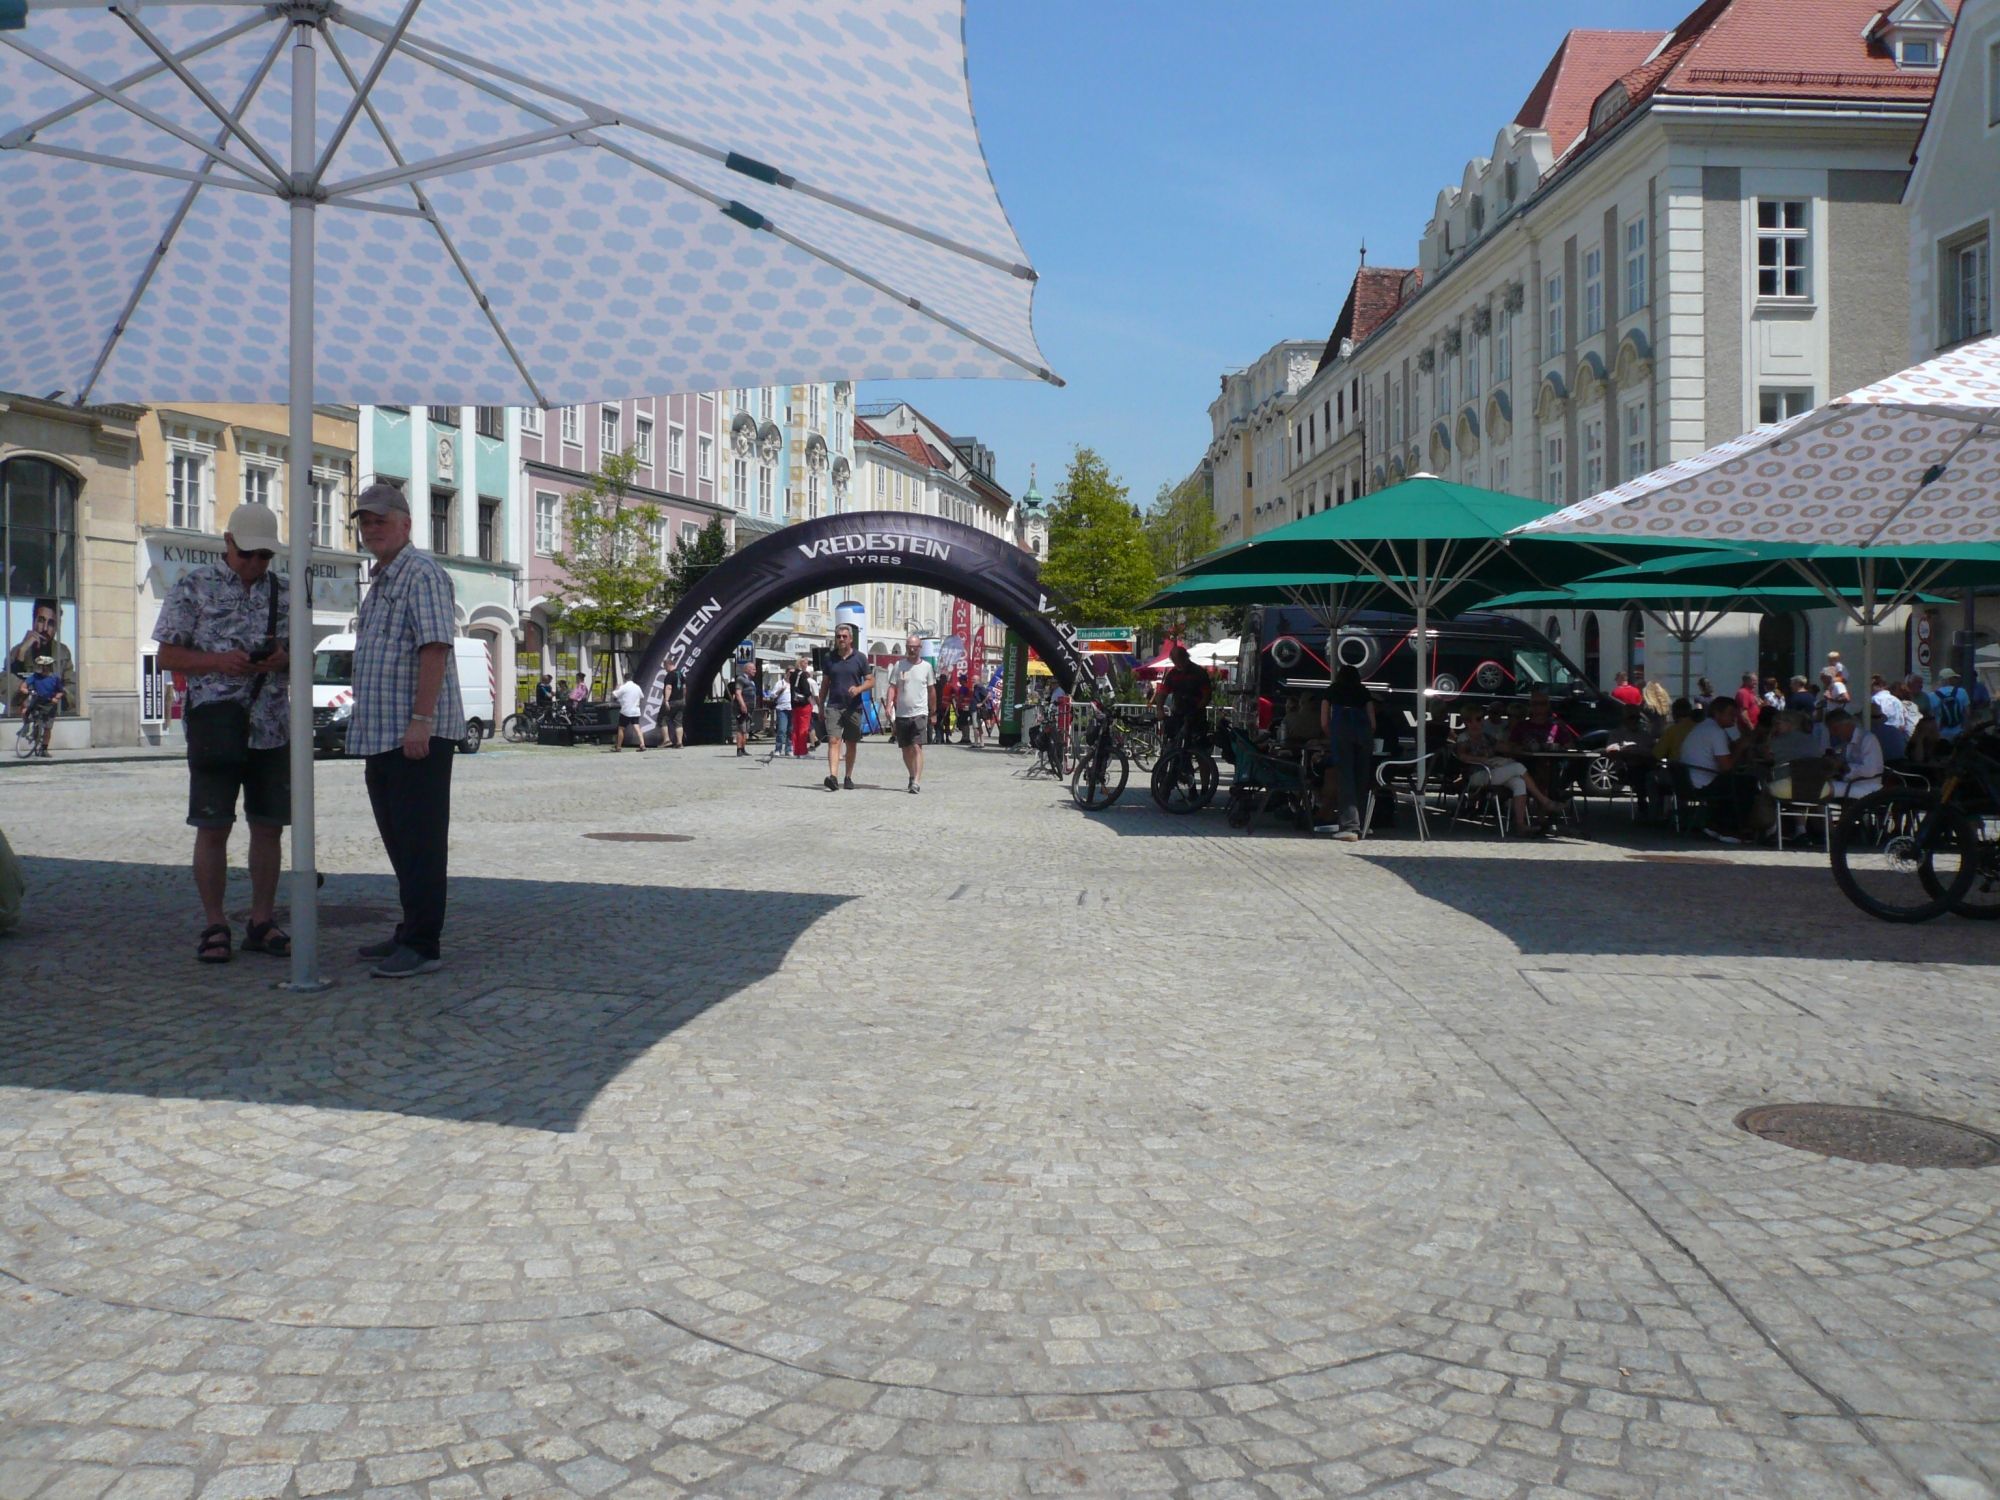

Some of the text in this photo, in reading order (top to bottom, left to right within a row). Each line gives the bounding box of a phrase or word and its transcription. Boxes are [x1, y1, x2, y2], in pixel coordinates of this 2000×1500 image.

[798, 533, 950, 561] VREDESTEIN
[845, 555, 902, 565] TYRES
[681, 646, 702, 678] RES
